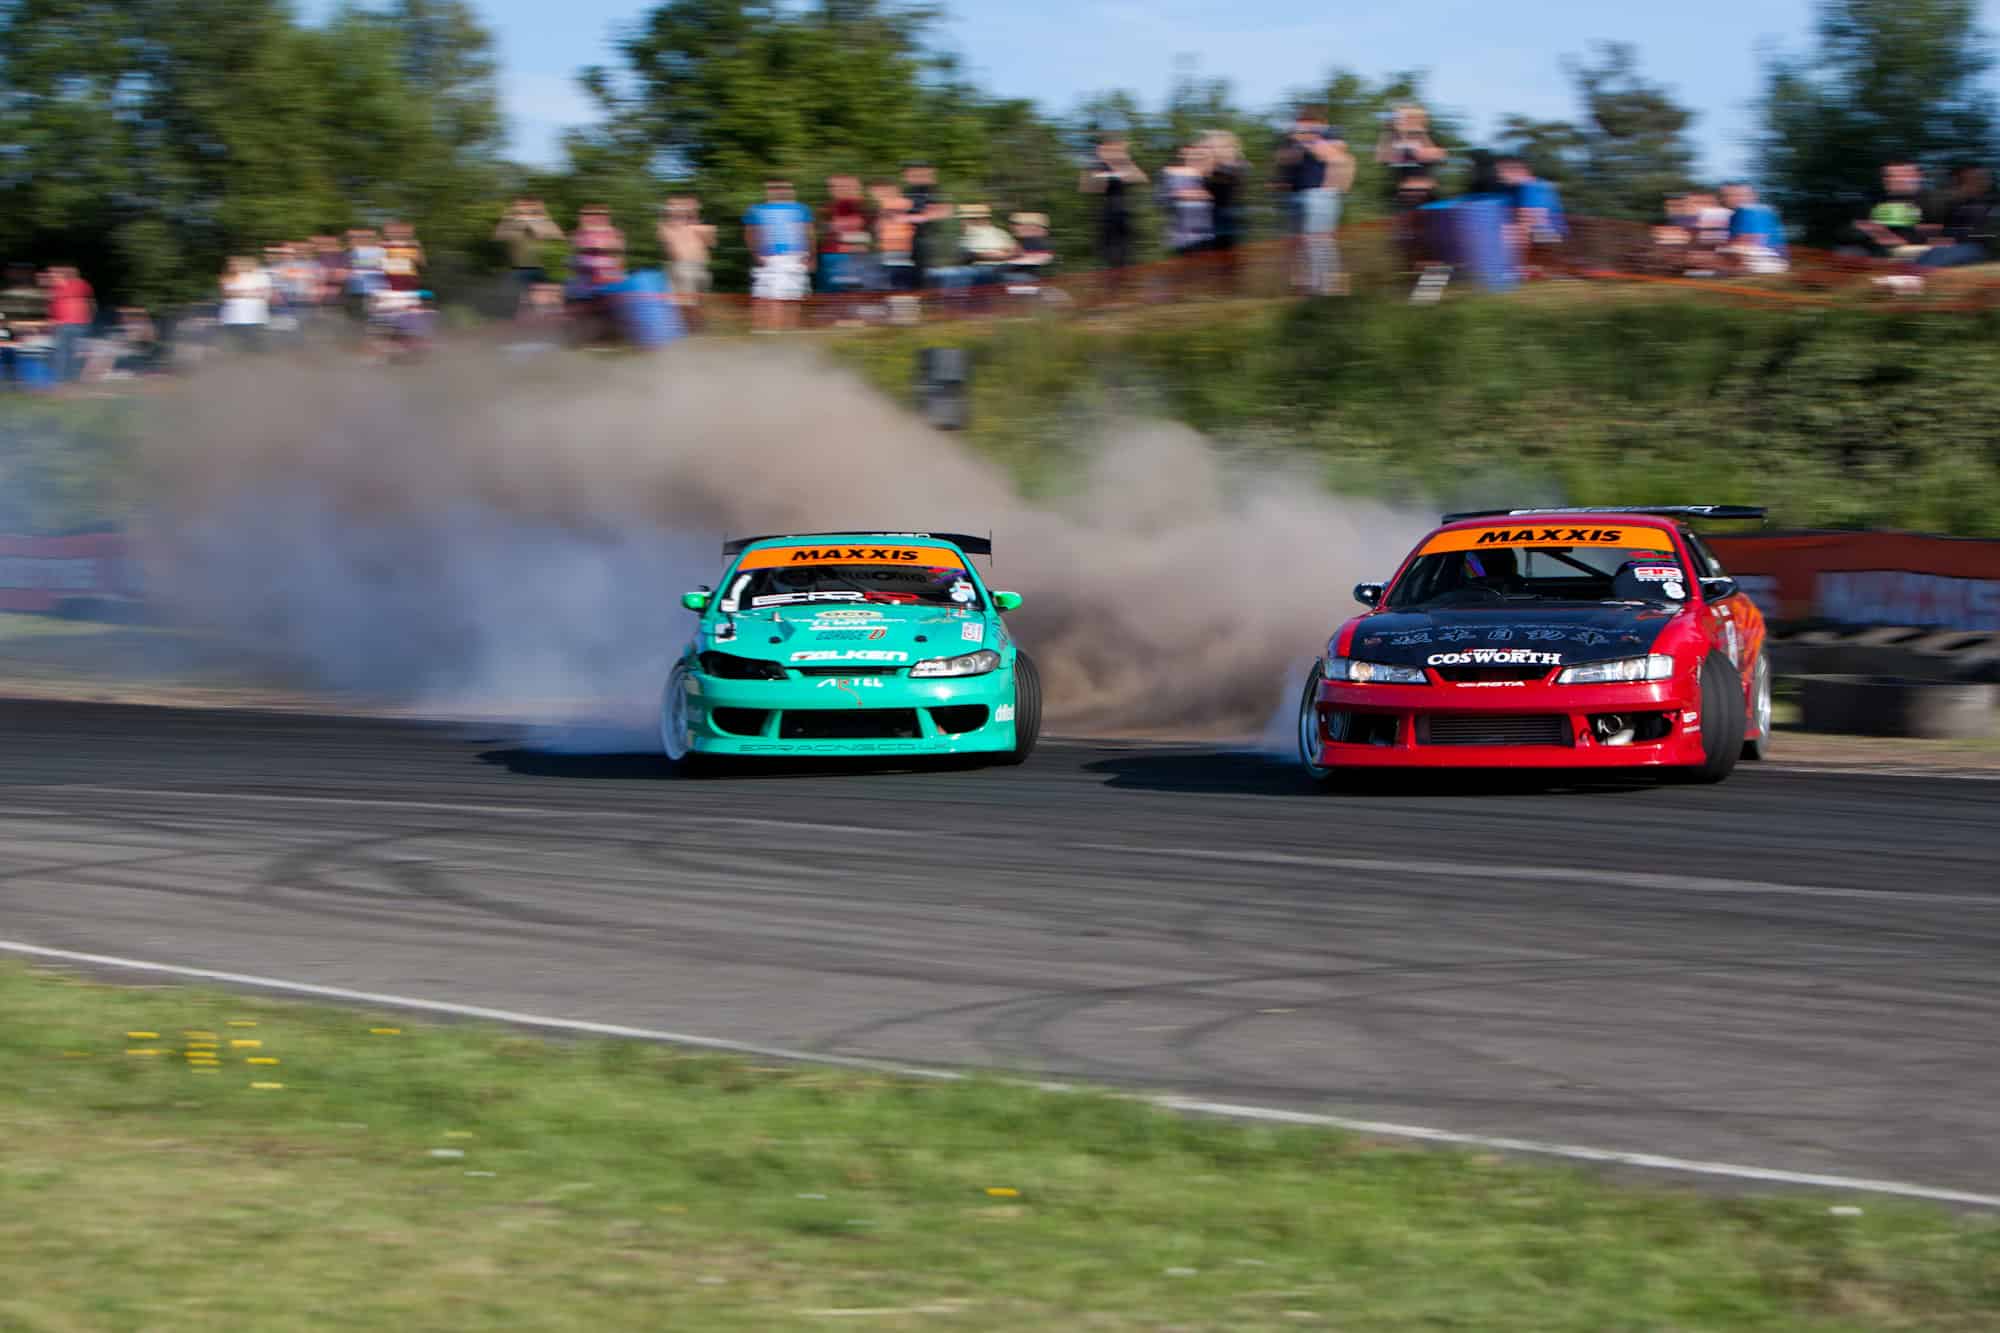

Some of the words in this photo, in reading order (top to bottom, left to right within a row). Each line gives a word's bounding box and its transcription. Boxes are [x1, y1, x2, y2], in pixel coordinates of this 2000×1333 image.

[1476, 528, 1622, 543] MAXXIS
[791, 549, 919, 561] MAXXIS
[790, 650, 908, 662] FALKEN
[1427, 652, 1562, 665] COSWORTH
